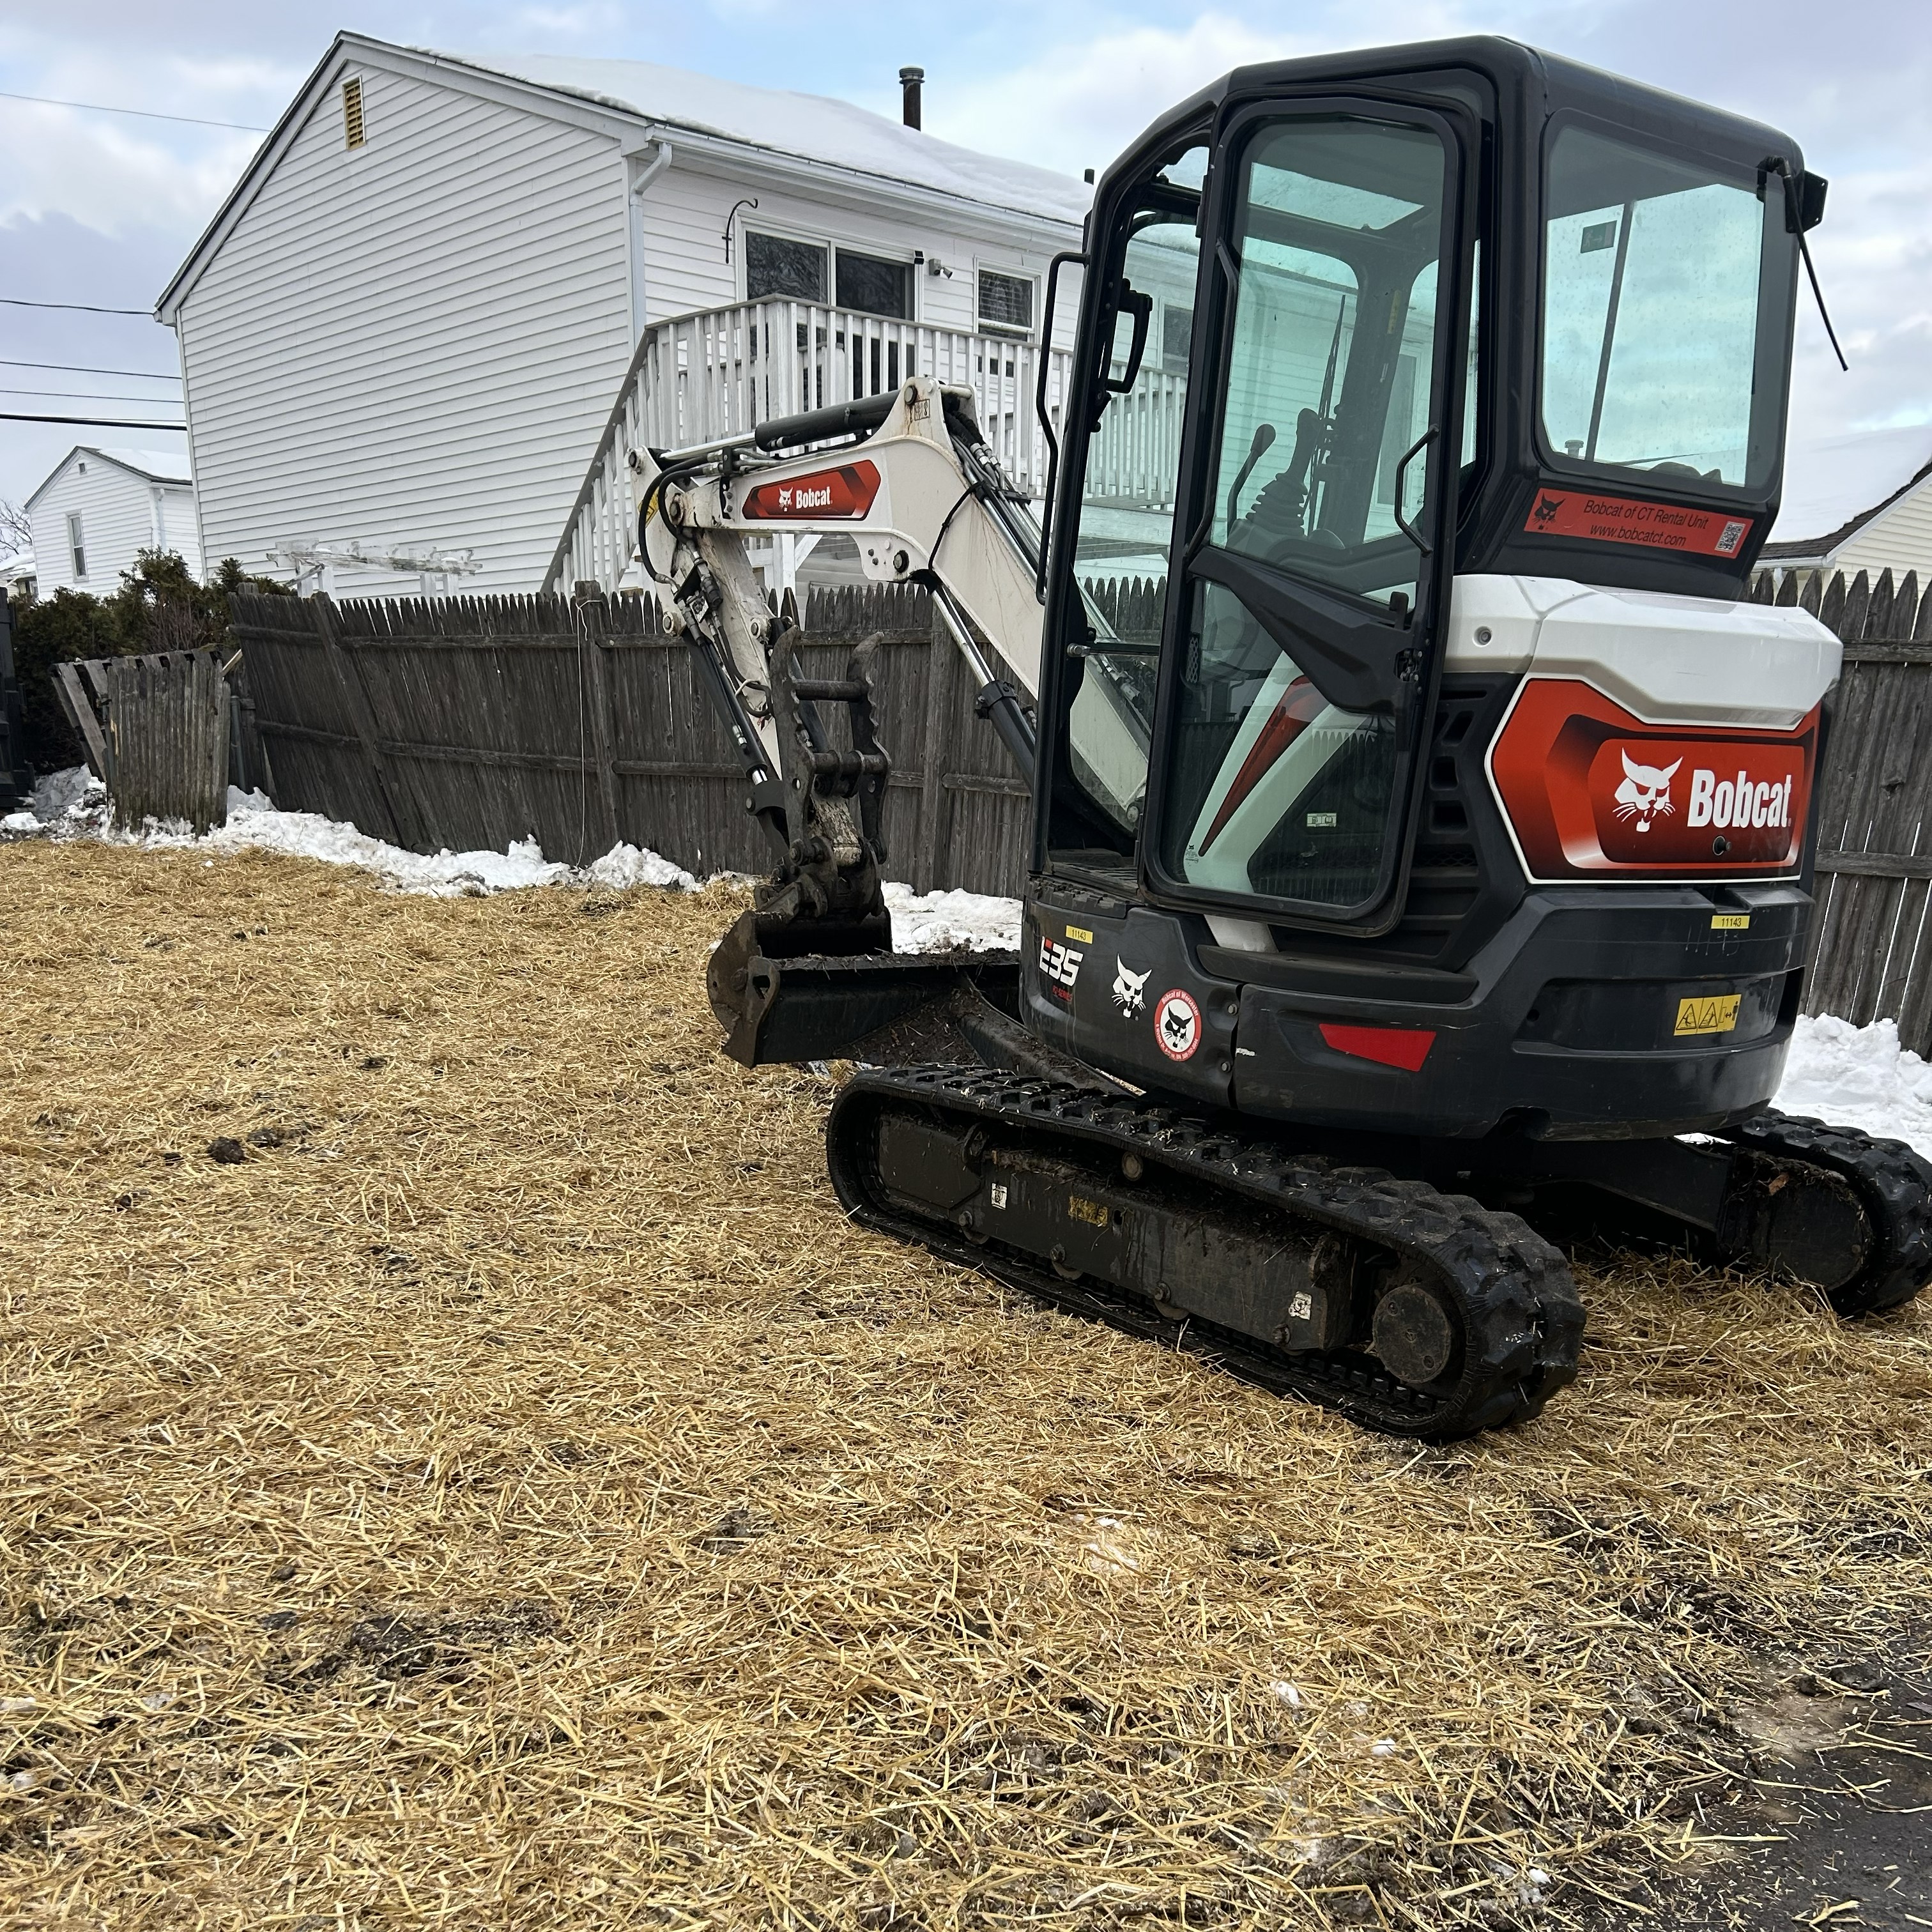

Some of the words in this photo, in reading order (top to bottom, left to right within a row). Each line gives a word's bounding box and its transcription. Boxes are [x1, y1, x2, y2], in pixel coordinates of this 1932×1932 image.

[796, 486, 831, 509] Bobcat
[1584, 500, 1623, 517] Bobcat
[1624, 505, 1639, 519] of
[1637, 507, 1655, 521] CT
[1653, 510, 1688, 526] Rental
[1687, 514, 1710, 530] Unit
[1590, 525, 1687, 547] www.bobcatct.com
[1687, 769, 1791, 828] Bobcat
[1721, 917, 1742, 927] 11143
[1071, 929, 1087, 940] 11143
[1039, 935, 1084, 987] E35
